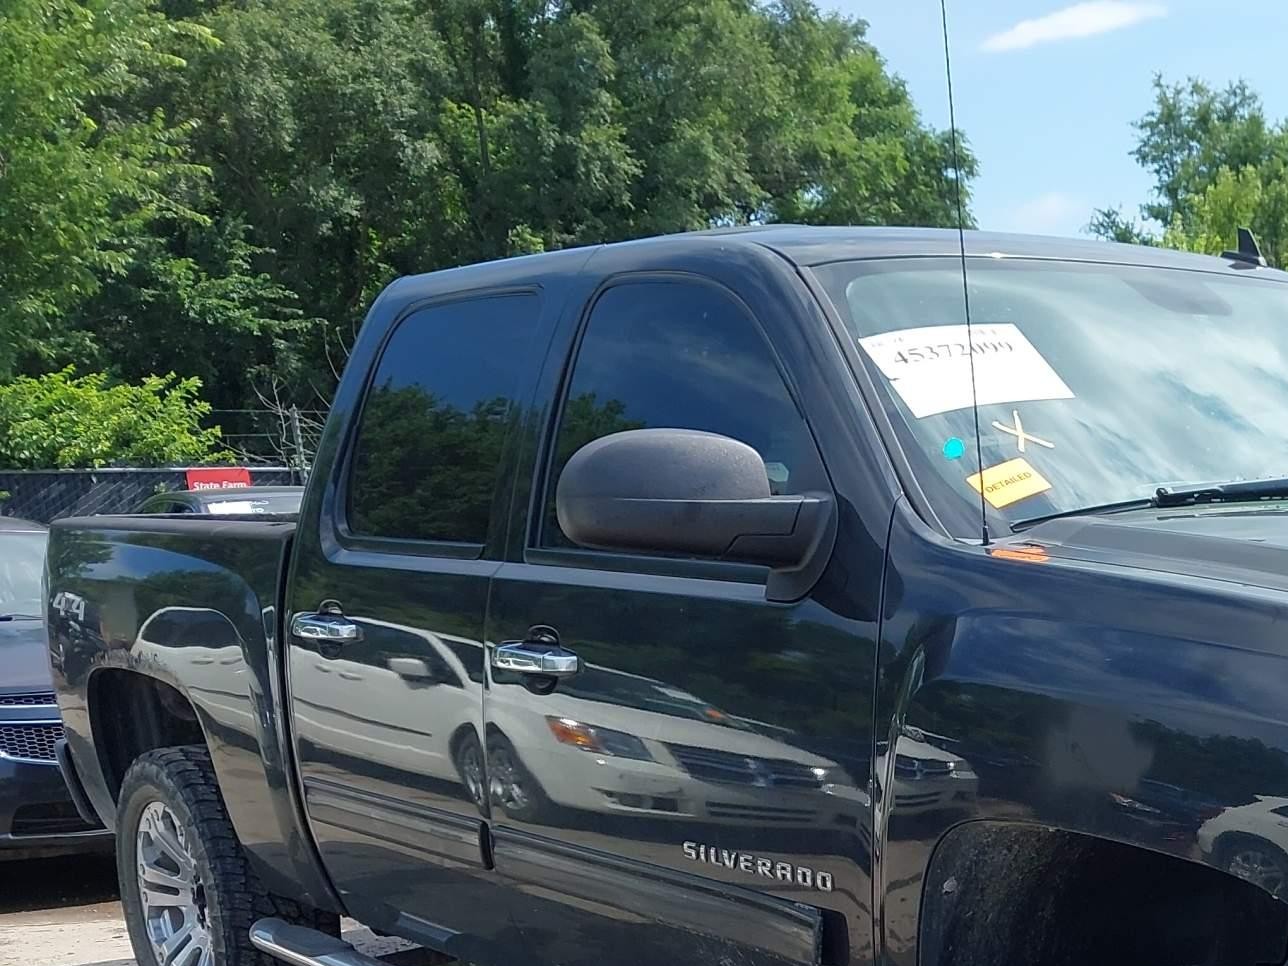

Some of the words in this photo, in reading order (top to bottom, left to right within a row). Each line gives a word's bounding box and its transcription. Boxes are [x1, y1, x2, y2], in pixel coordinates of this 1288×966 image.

[193, 481, 220, 490] State
[222, 481, 247, 489] Farm
[985, 472, 1032, 493] DETAILED
[682, 841, 833, 892] SILVERADO
